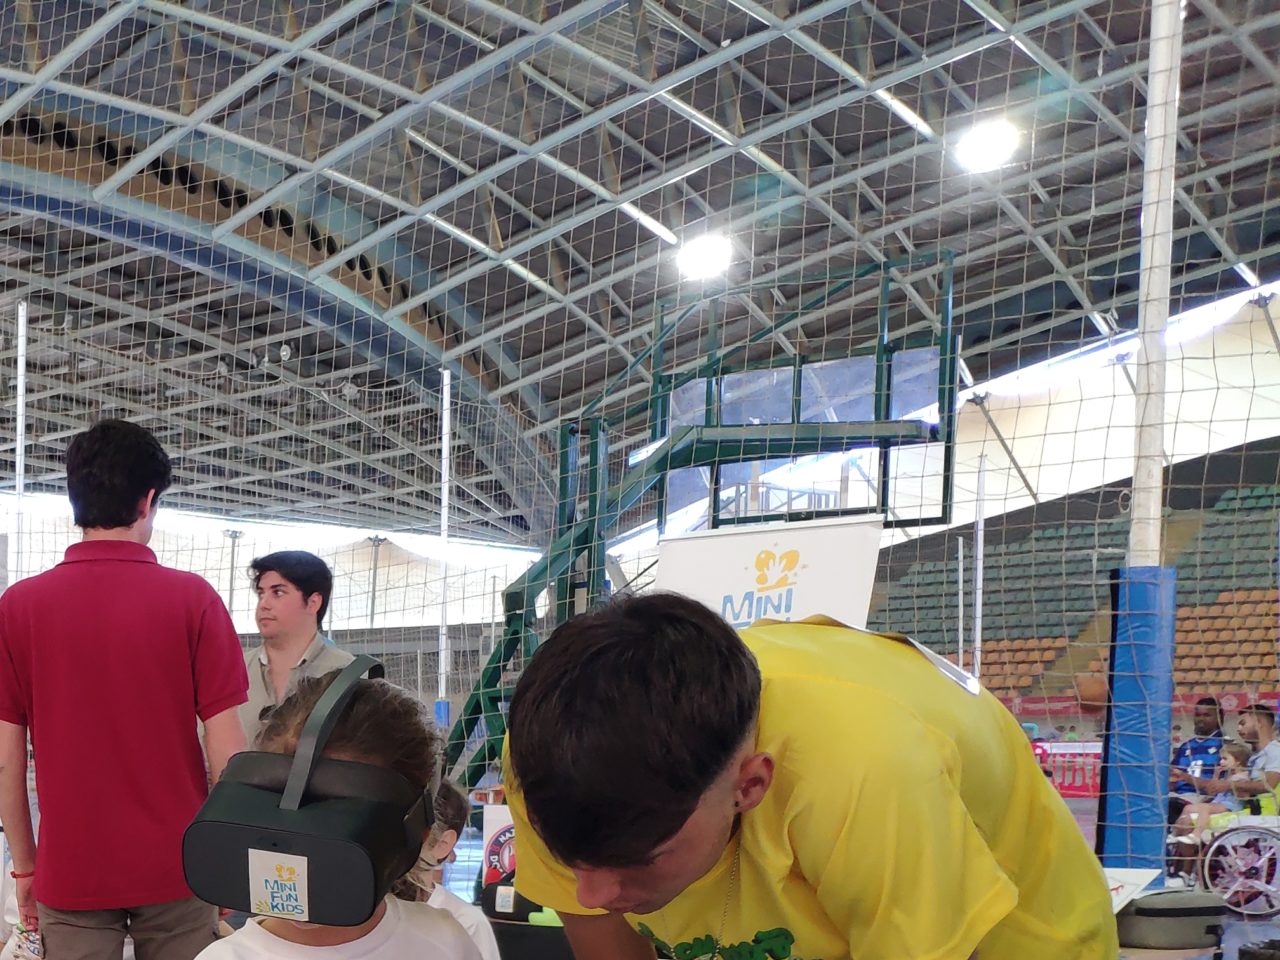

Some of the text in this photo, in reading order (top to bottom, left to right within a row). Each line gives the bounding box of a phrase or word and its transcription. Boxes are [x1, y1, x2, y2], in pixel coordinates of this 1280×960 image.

[721, 588, 793, 621] MINI
[264, 879, 297, 892] MINI
[270, 891, 299, 903] FUN
[270, 902, 305, 915] KIDS
